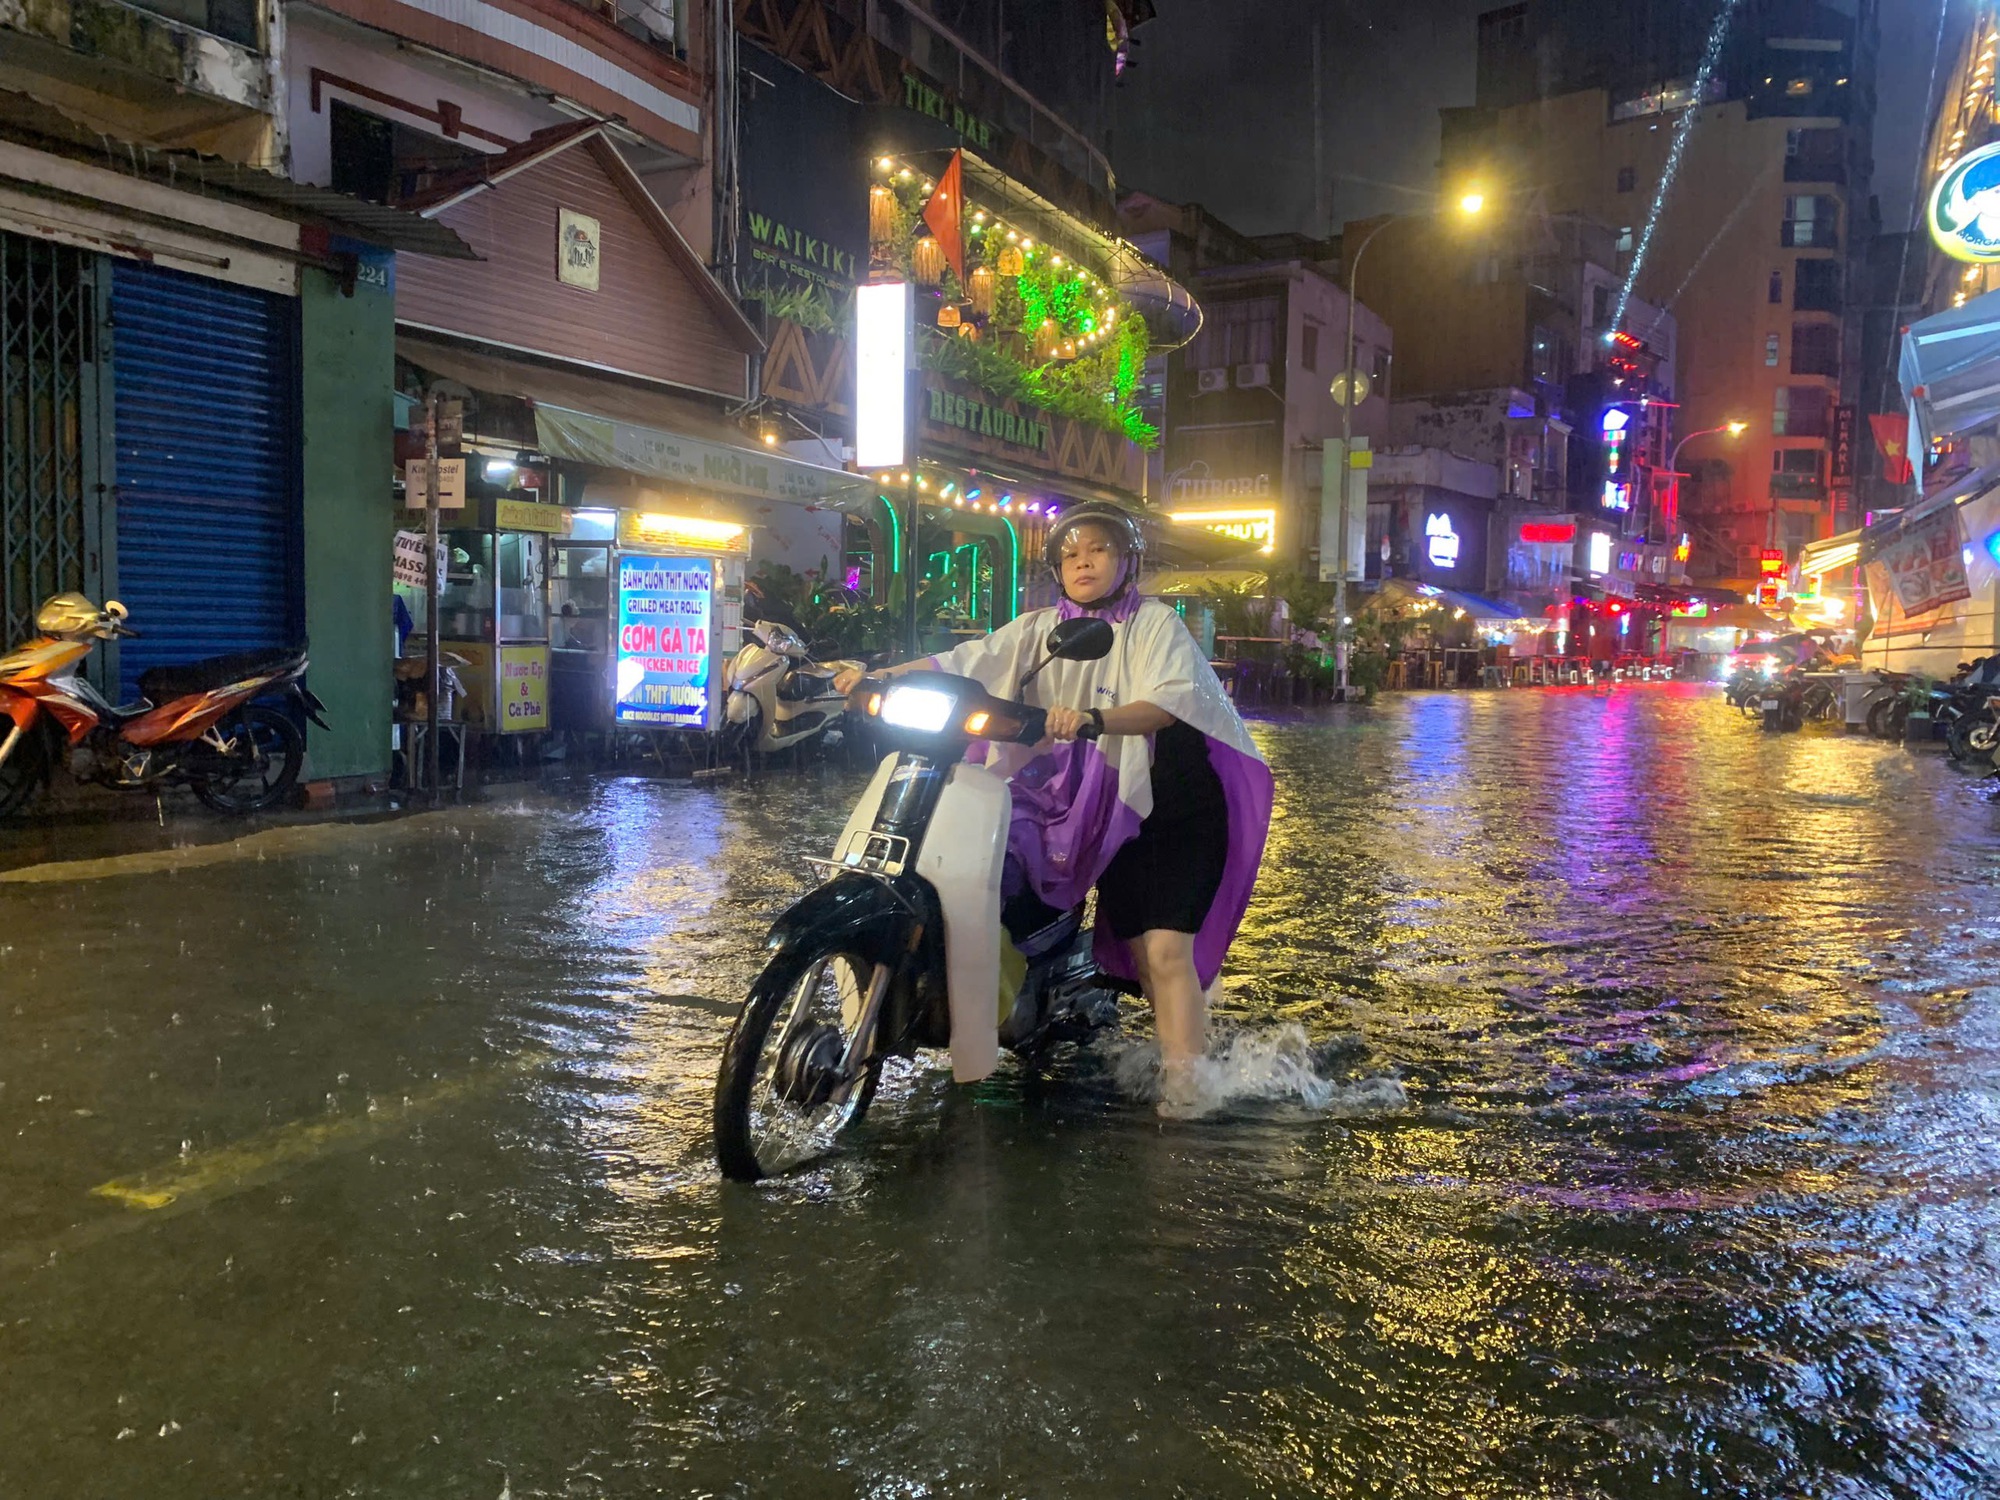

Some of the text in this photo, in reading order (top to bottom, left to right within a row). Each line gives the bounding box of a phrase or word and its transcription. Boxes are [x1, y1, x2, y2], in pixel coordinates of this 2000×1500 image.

[903, 74, 989, 150] TIKI BAR
[748, 211, 856, 280] WAIKIKI
[753, 248, 776, 266] BAR
[357, 262, 386, 286] 224
[930, 387, 1050, 453] RESTAURANT
[1838, 410, 1852, 475] MERAKI
[437, 464, 460, 475] ostel
[1174, 473, 1270, 501] TUBORG
[627, 599, 703, 615] GRILLED MEAT ROLLS
[621, 621, 708, 655] CƠM GÀ TA
[629, 656, 700, 674] ICKEN RICE
[520, 681, 529, 697] &
